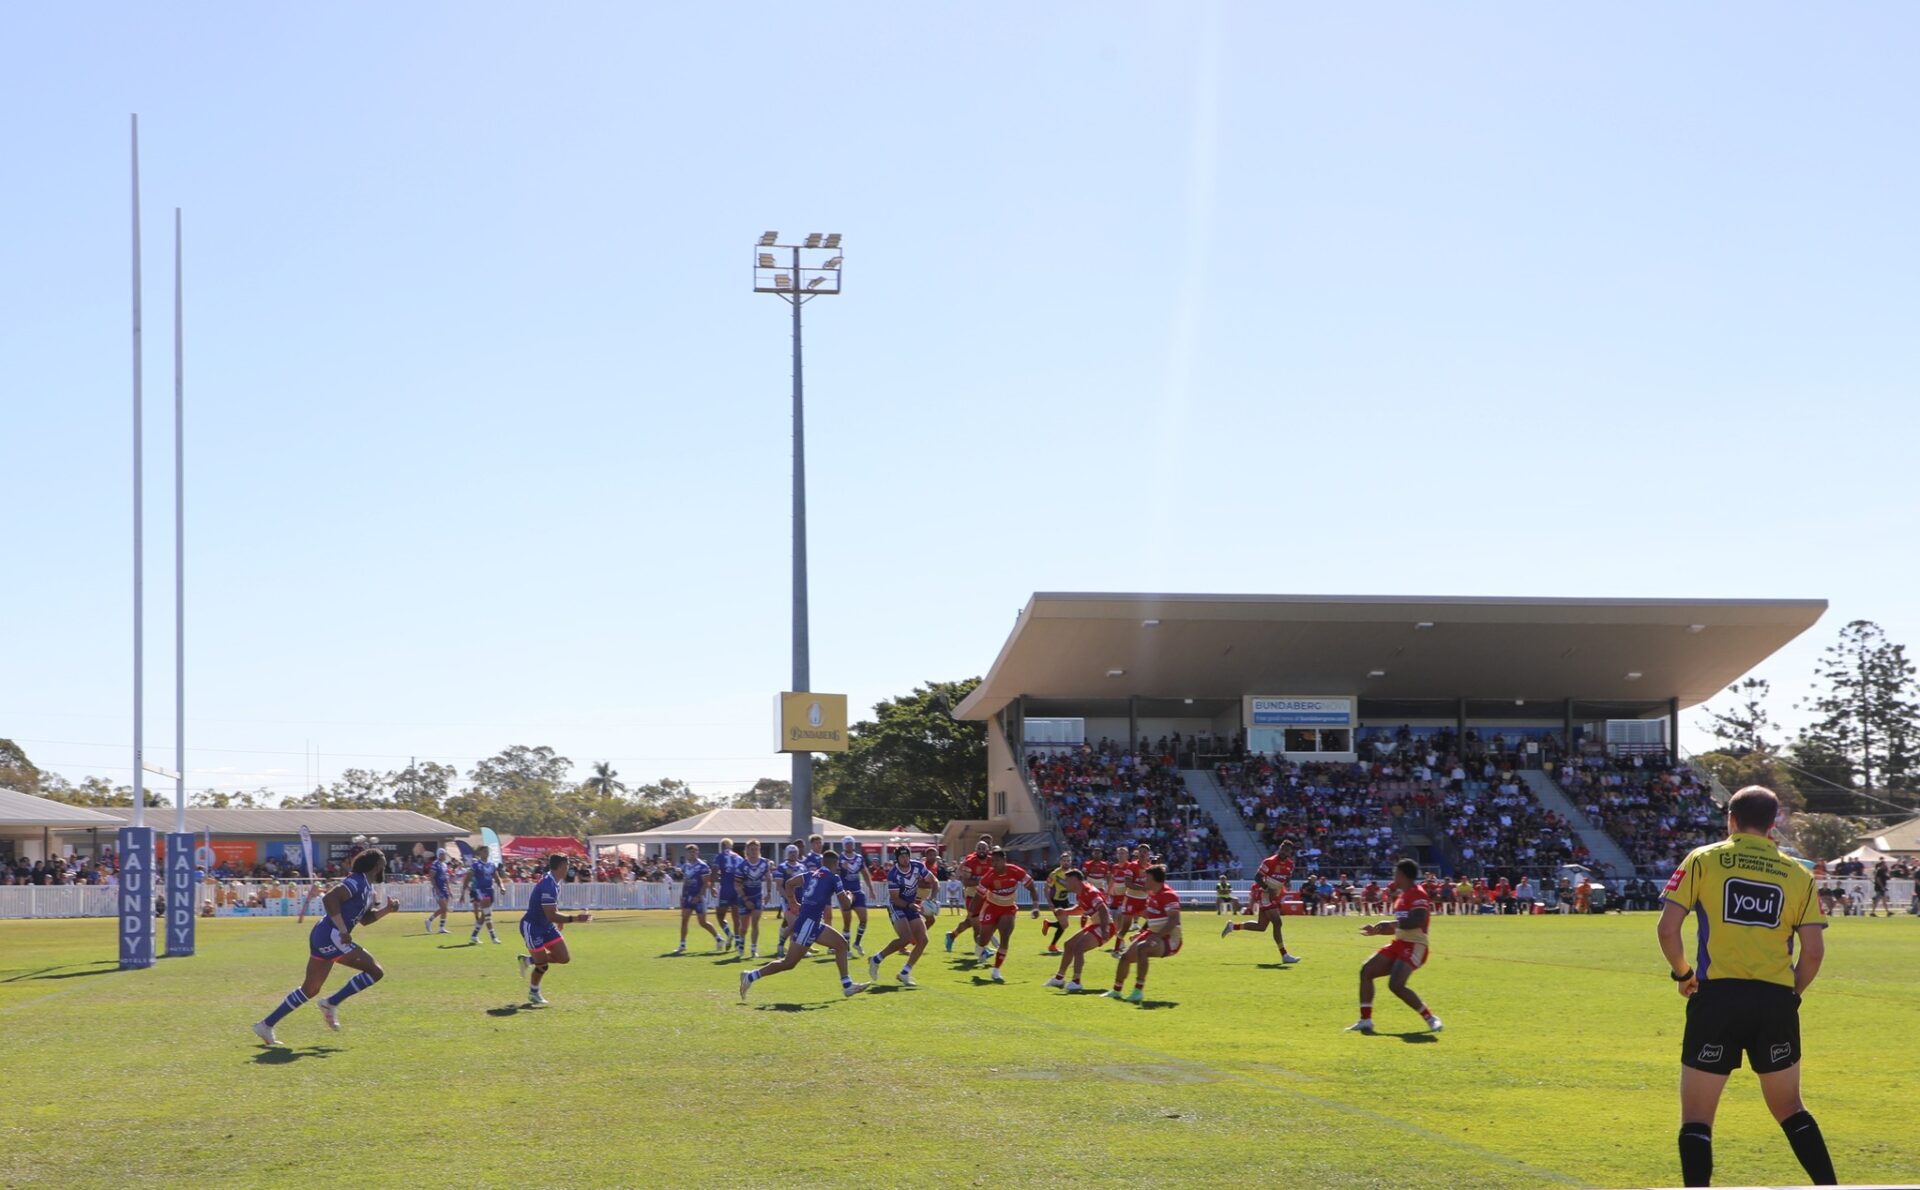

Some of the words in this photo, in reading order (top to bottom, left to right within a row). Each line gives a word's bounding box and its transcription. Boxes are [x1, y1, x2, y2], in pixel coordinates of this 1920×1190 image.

[1738, 863, 1764, 872] LEAGUE
[124, 831, 142, 955] LAUNDY
[174, 836, 190, 944] LAUNDY
[803, 879, 818, 898] 3
[1733, 892, 1775, 914] youi
[1702, 1048, 1719, 1058] youi
